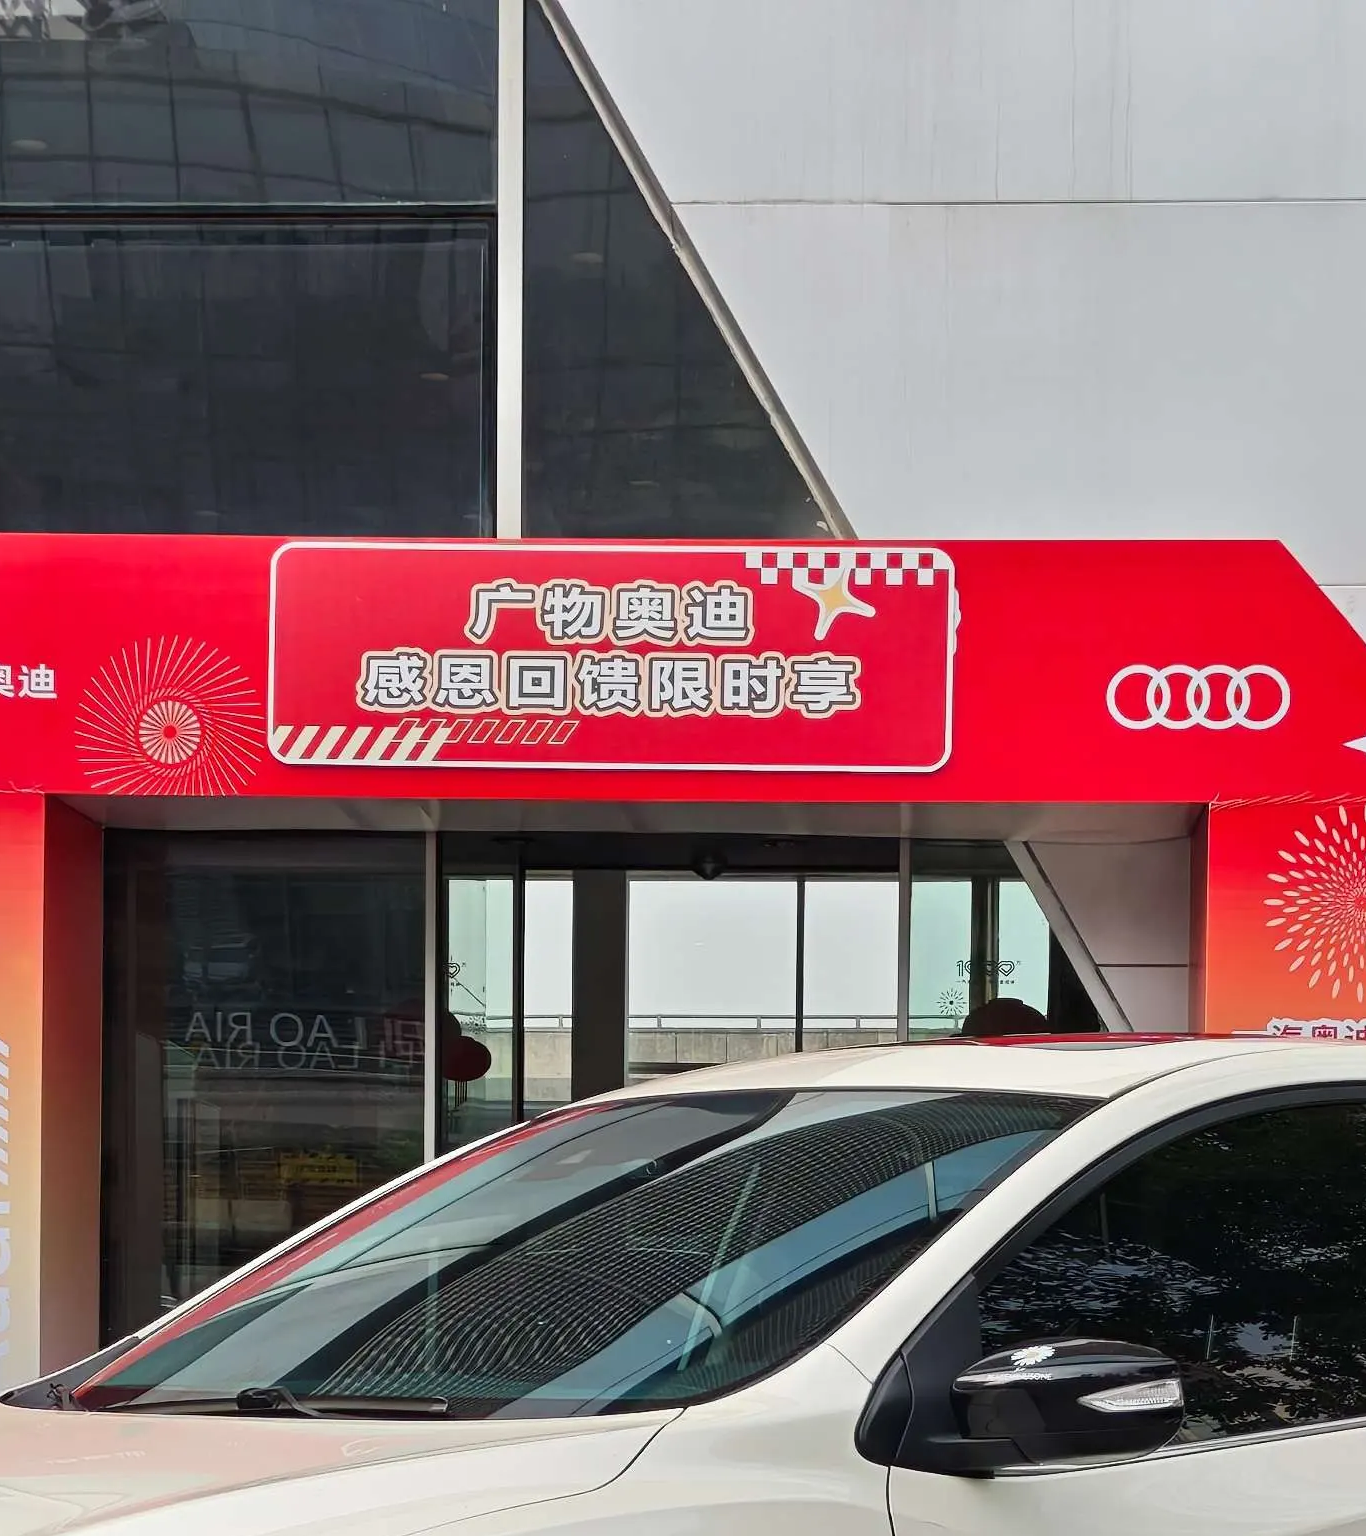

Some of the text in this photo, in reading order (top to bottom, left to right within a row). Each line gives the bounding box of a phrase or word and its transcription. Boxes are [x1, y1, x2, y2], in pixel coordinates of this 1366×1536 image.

[465, 578, 754, 645] 广物奥迪
[359, 651, 860, 717] 感恩回馈限时享
